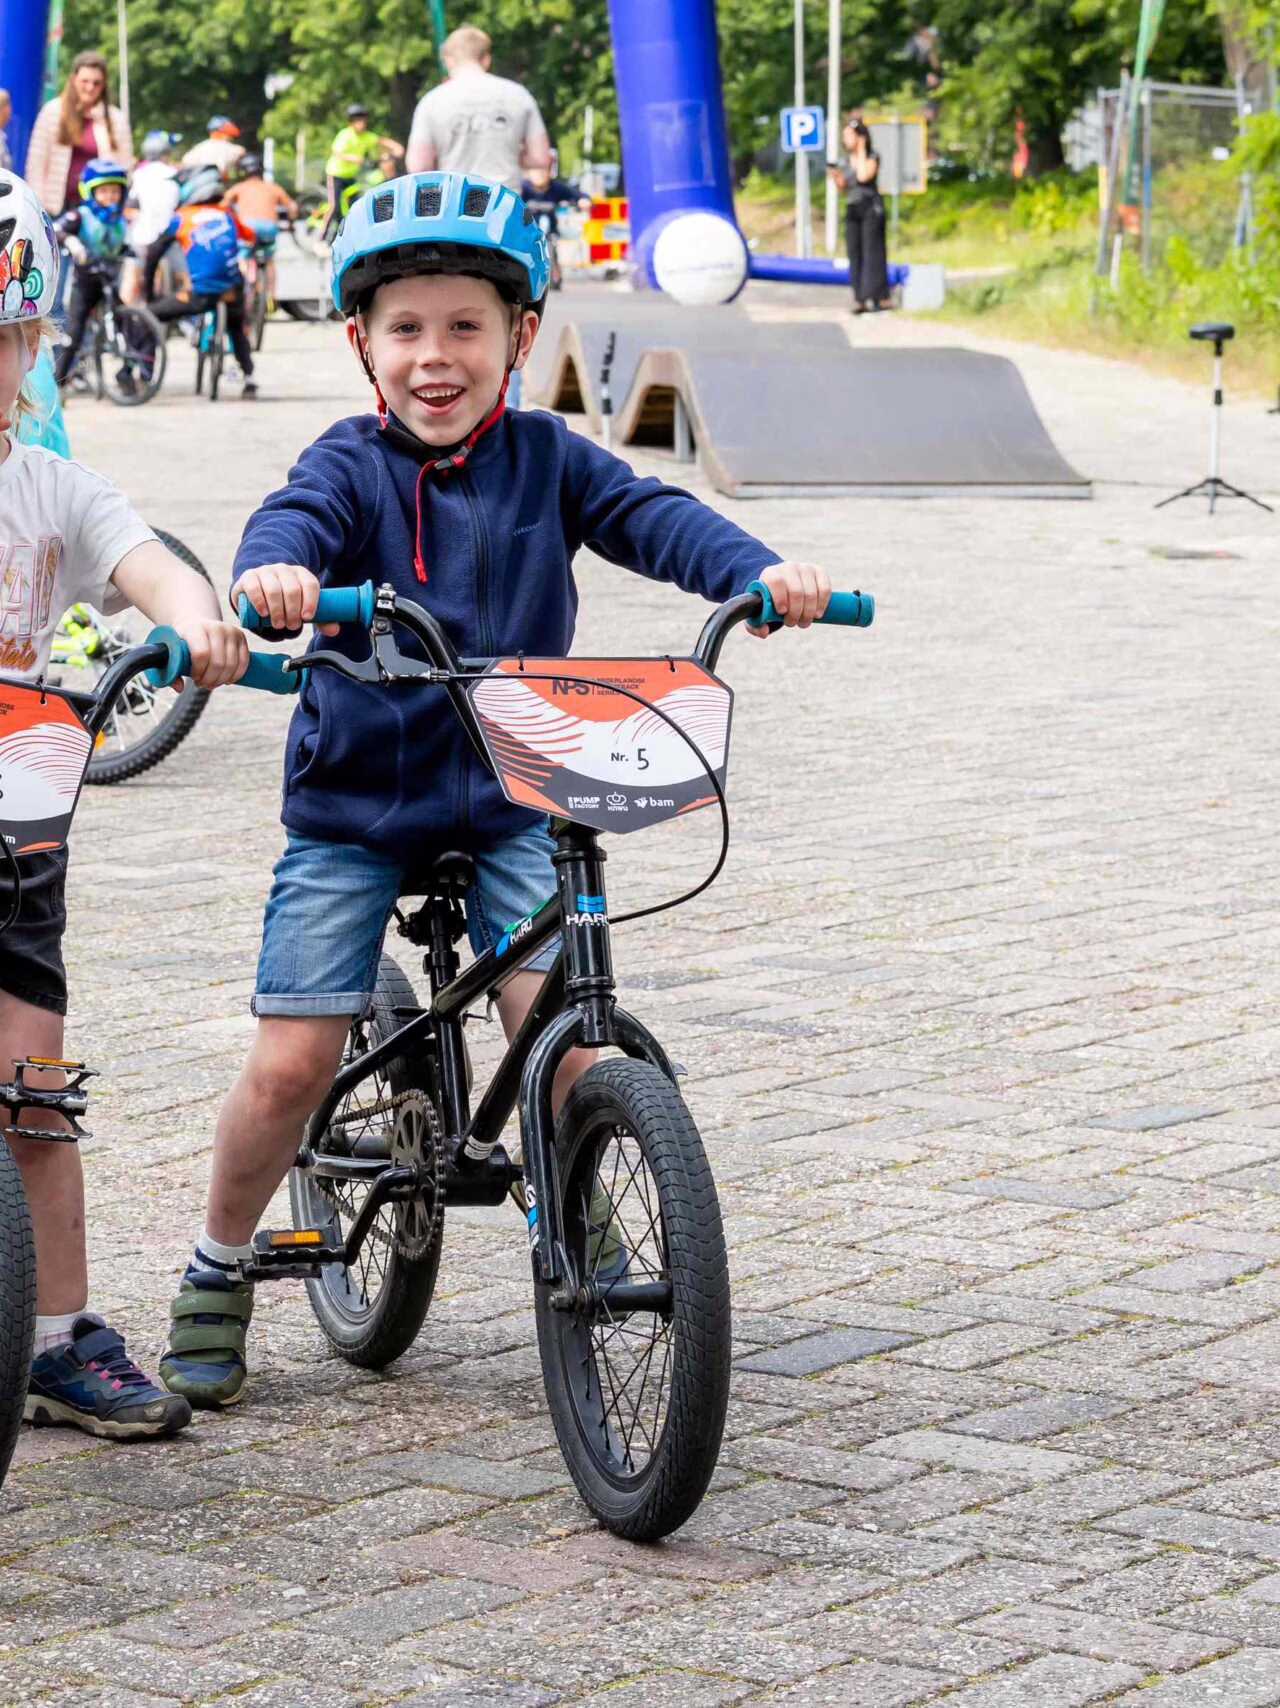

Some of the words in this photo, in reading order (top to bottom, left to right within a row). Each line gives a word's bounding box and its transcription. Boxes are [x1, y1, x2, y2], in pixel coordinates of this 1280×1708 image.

[791, 113, 815, 147] P
[552, 678, 590, 696] NPS
[611, 752, 629, 762] Nr.
[637, 748, 650, 770] 5
[573, 796, 600, 804] PUMP
[649, 797, 674, 807] bam
[509, 917, 533, 945] HARO
